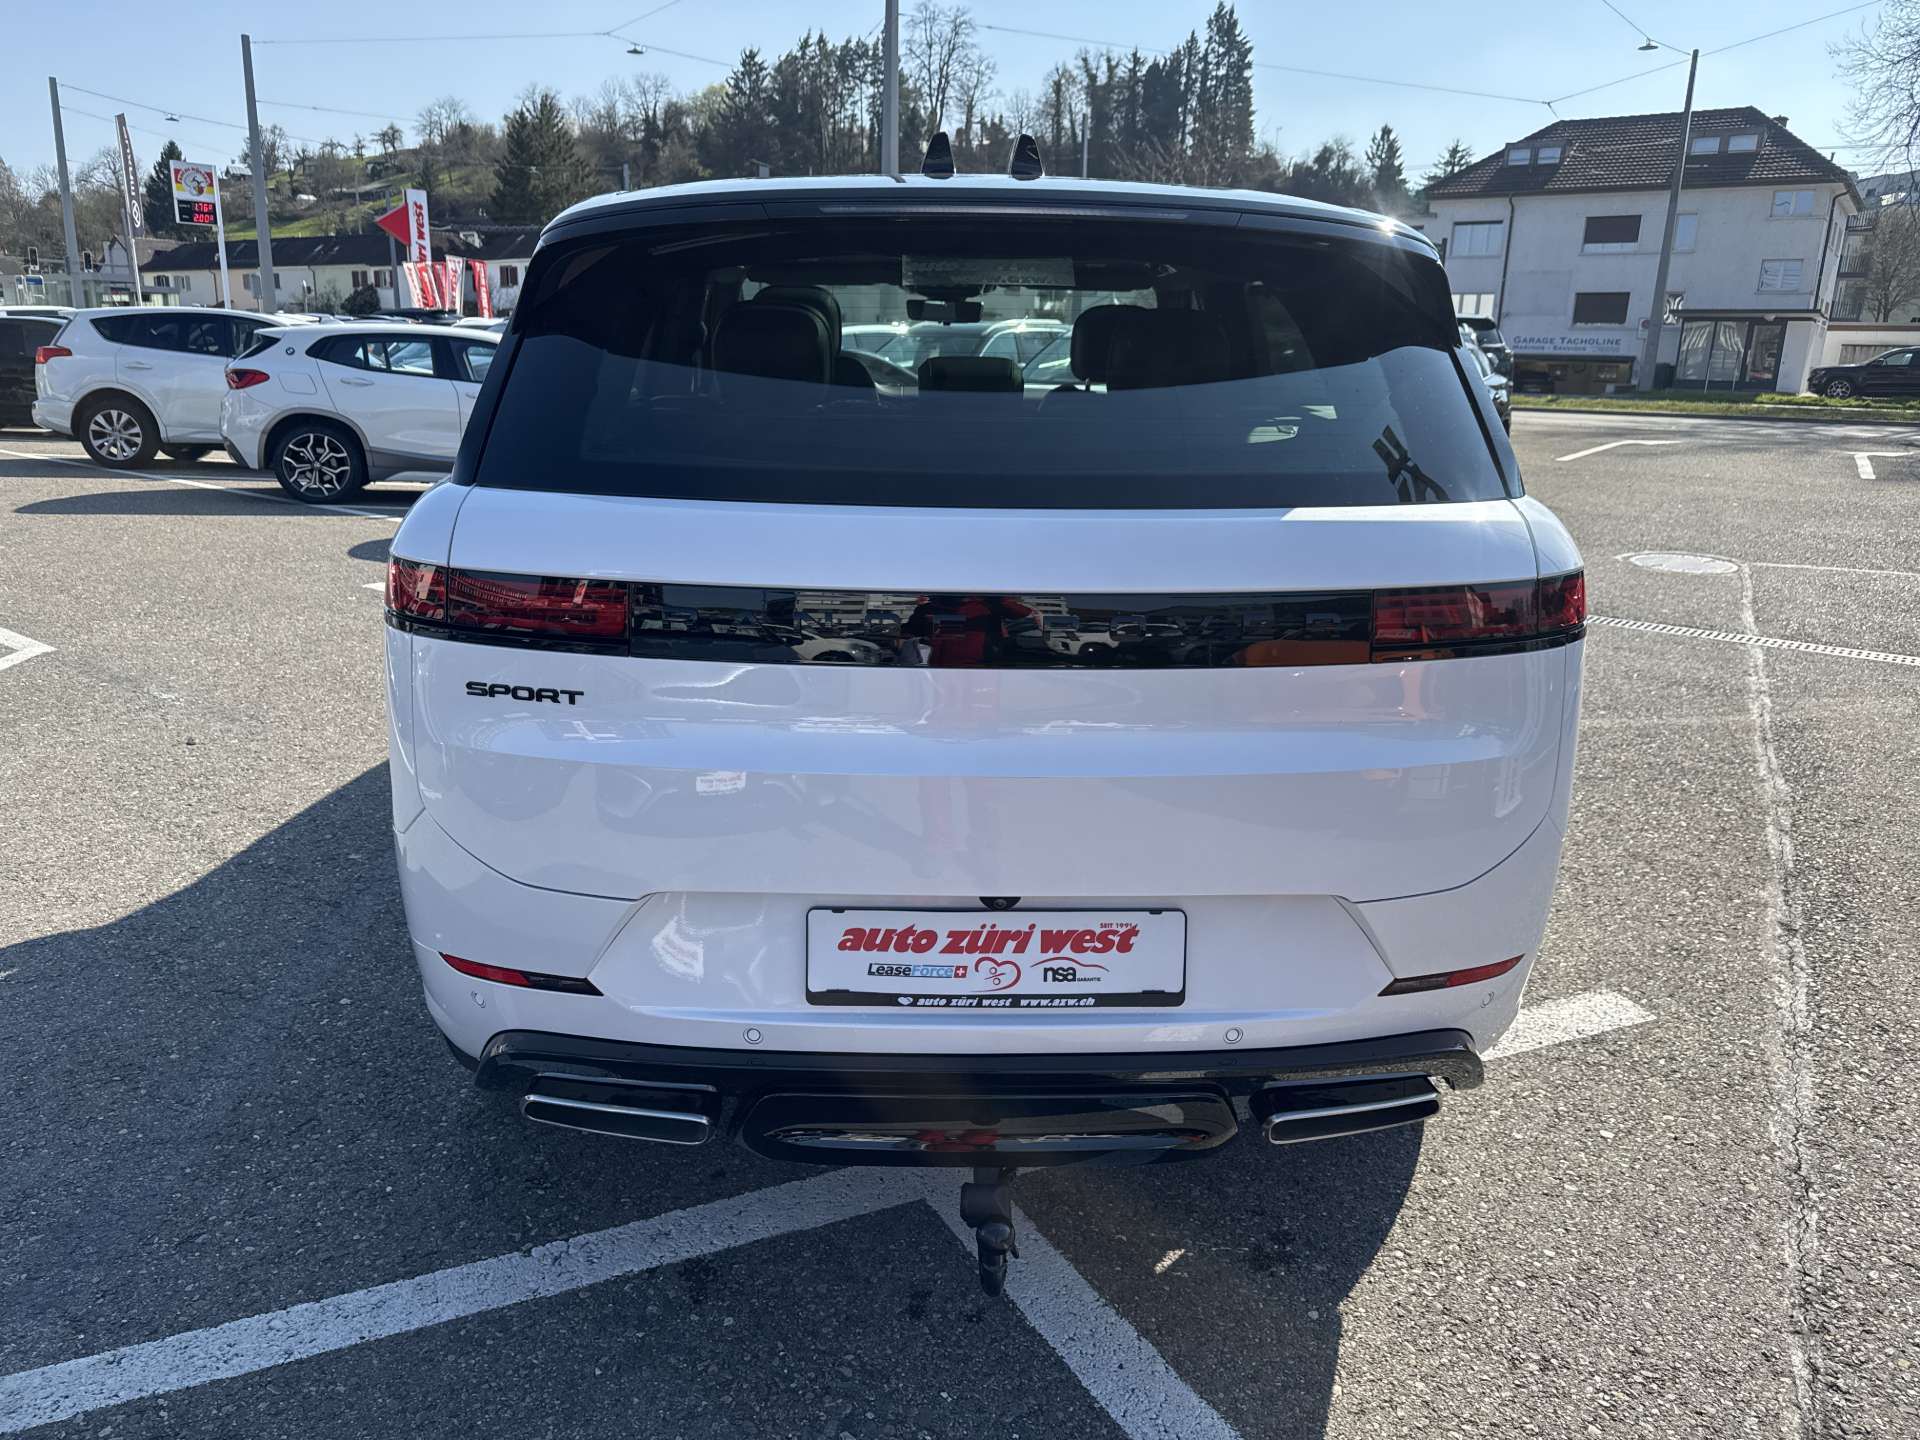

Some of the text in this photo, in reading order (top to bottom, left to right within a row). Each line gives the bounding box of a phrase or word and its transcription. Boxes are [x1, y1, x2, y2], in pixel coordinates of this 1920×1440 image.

[413, 200, 426, 241] west
[1513, 335, 1622, 346] GARAGE TACHOLINE
[466, 681, 585, 705] SPORT
[837, 923, 1140, 955] auto züri west
[867, 962, 954, 978] LeaseForce
[1043, 966, 1077, 983] nsa
[916, 996, 1096, 1008] auto züri west www.azw.ch
